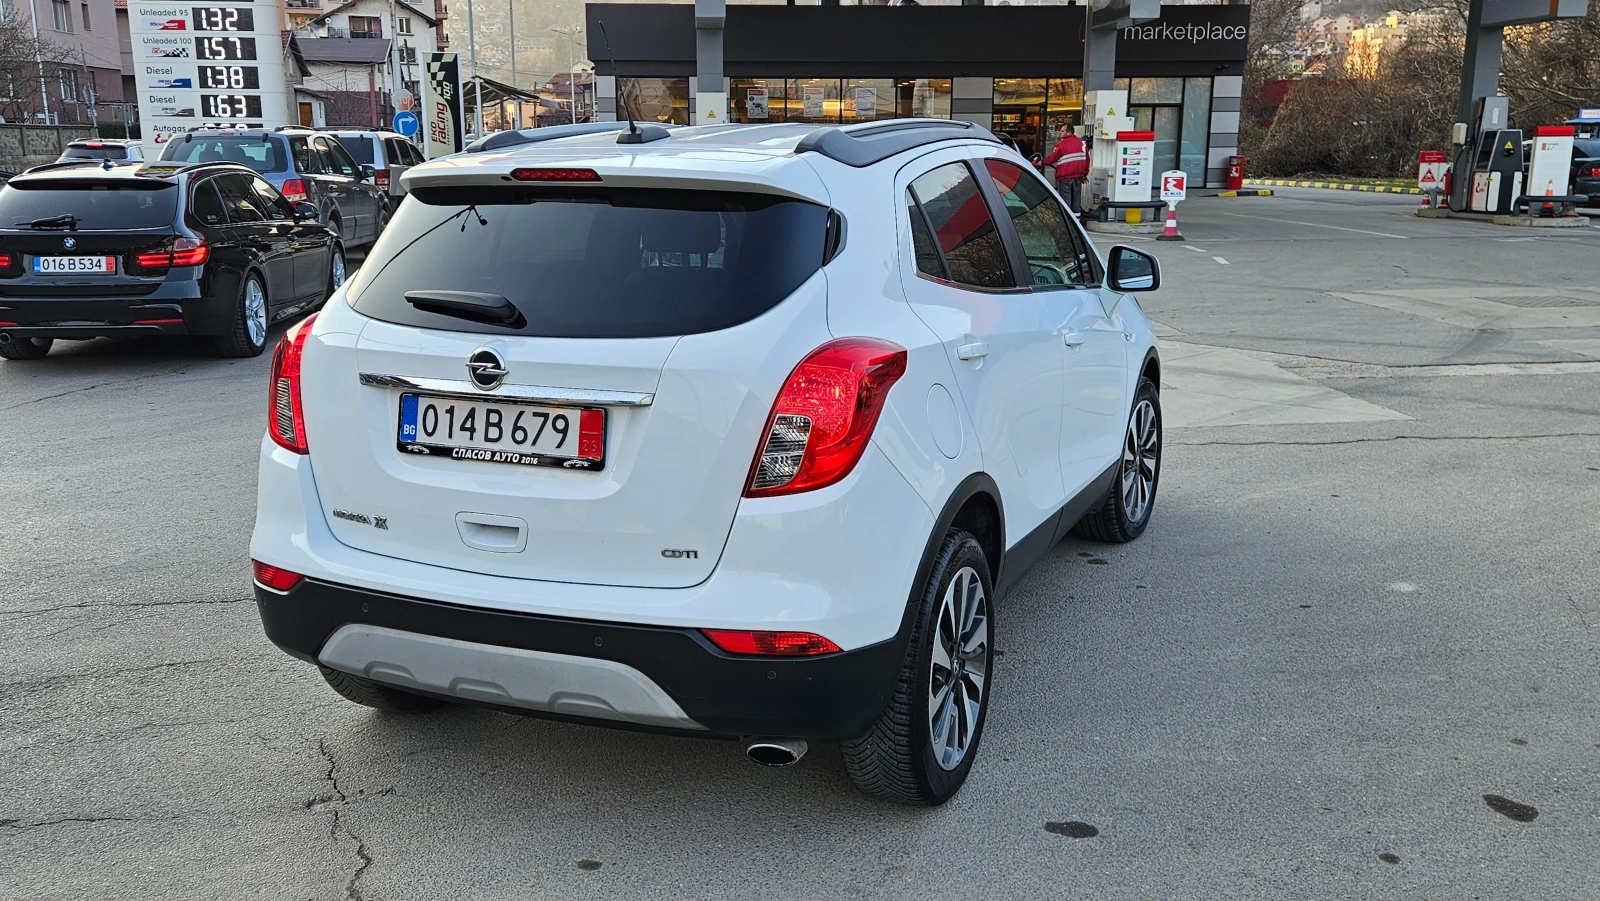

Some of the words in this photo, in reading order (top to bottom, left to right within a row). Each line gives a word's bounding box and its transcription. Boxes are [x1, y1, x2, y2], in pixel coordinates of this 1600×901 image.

[201, 8, 238, 30] 1.32
[1124, 22, 1247, 44] marketplace
[204, 37, 242, 60] 1.57
[146, 66, 173, 74] Diesel
[207, 66, 244, 89] 1.38
[149, 95, 176, 104] Diesel
[442, 81, 451, 100] 100
[210, 95, 247, 118] 1.63
[153, 125, 187, 133] Autogas
[430, 121, 438, 142] EKO
[436, 102, 448, 144] racing
[42, 258, 102, 271] 016B534
[403, 424, 416, 435] BG
[422, 403, 570, 449] 014B679
[582, 439, 598, 453] 26
[452, 448, 491, 460] СПАСОВ
[493, 452, 520, 463] АУТО
[520, 456, 539, 465] 2016
[660, 549, 699, 559] CDTI
